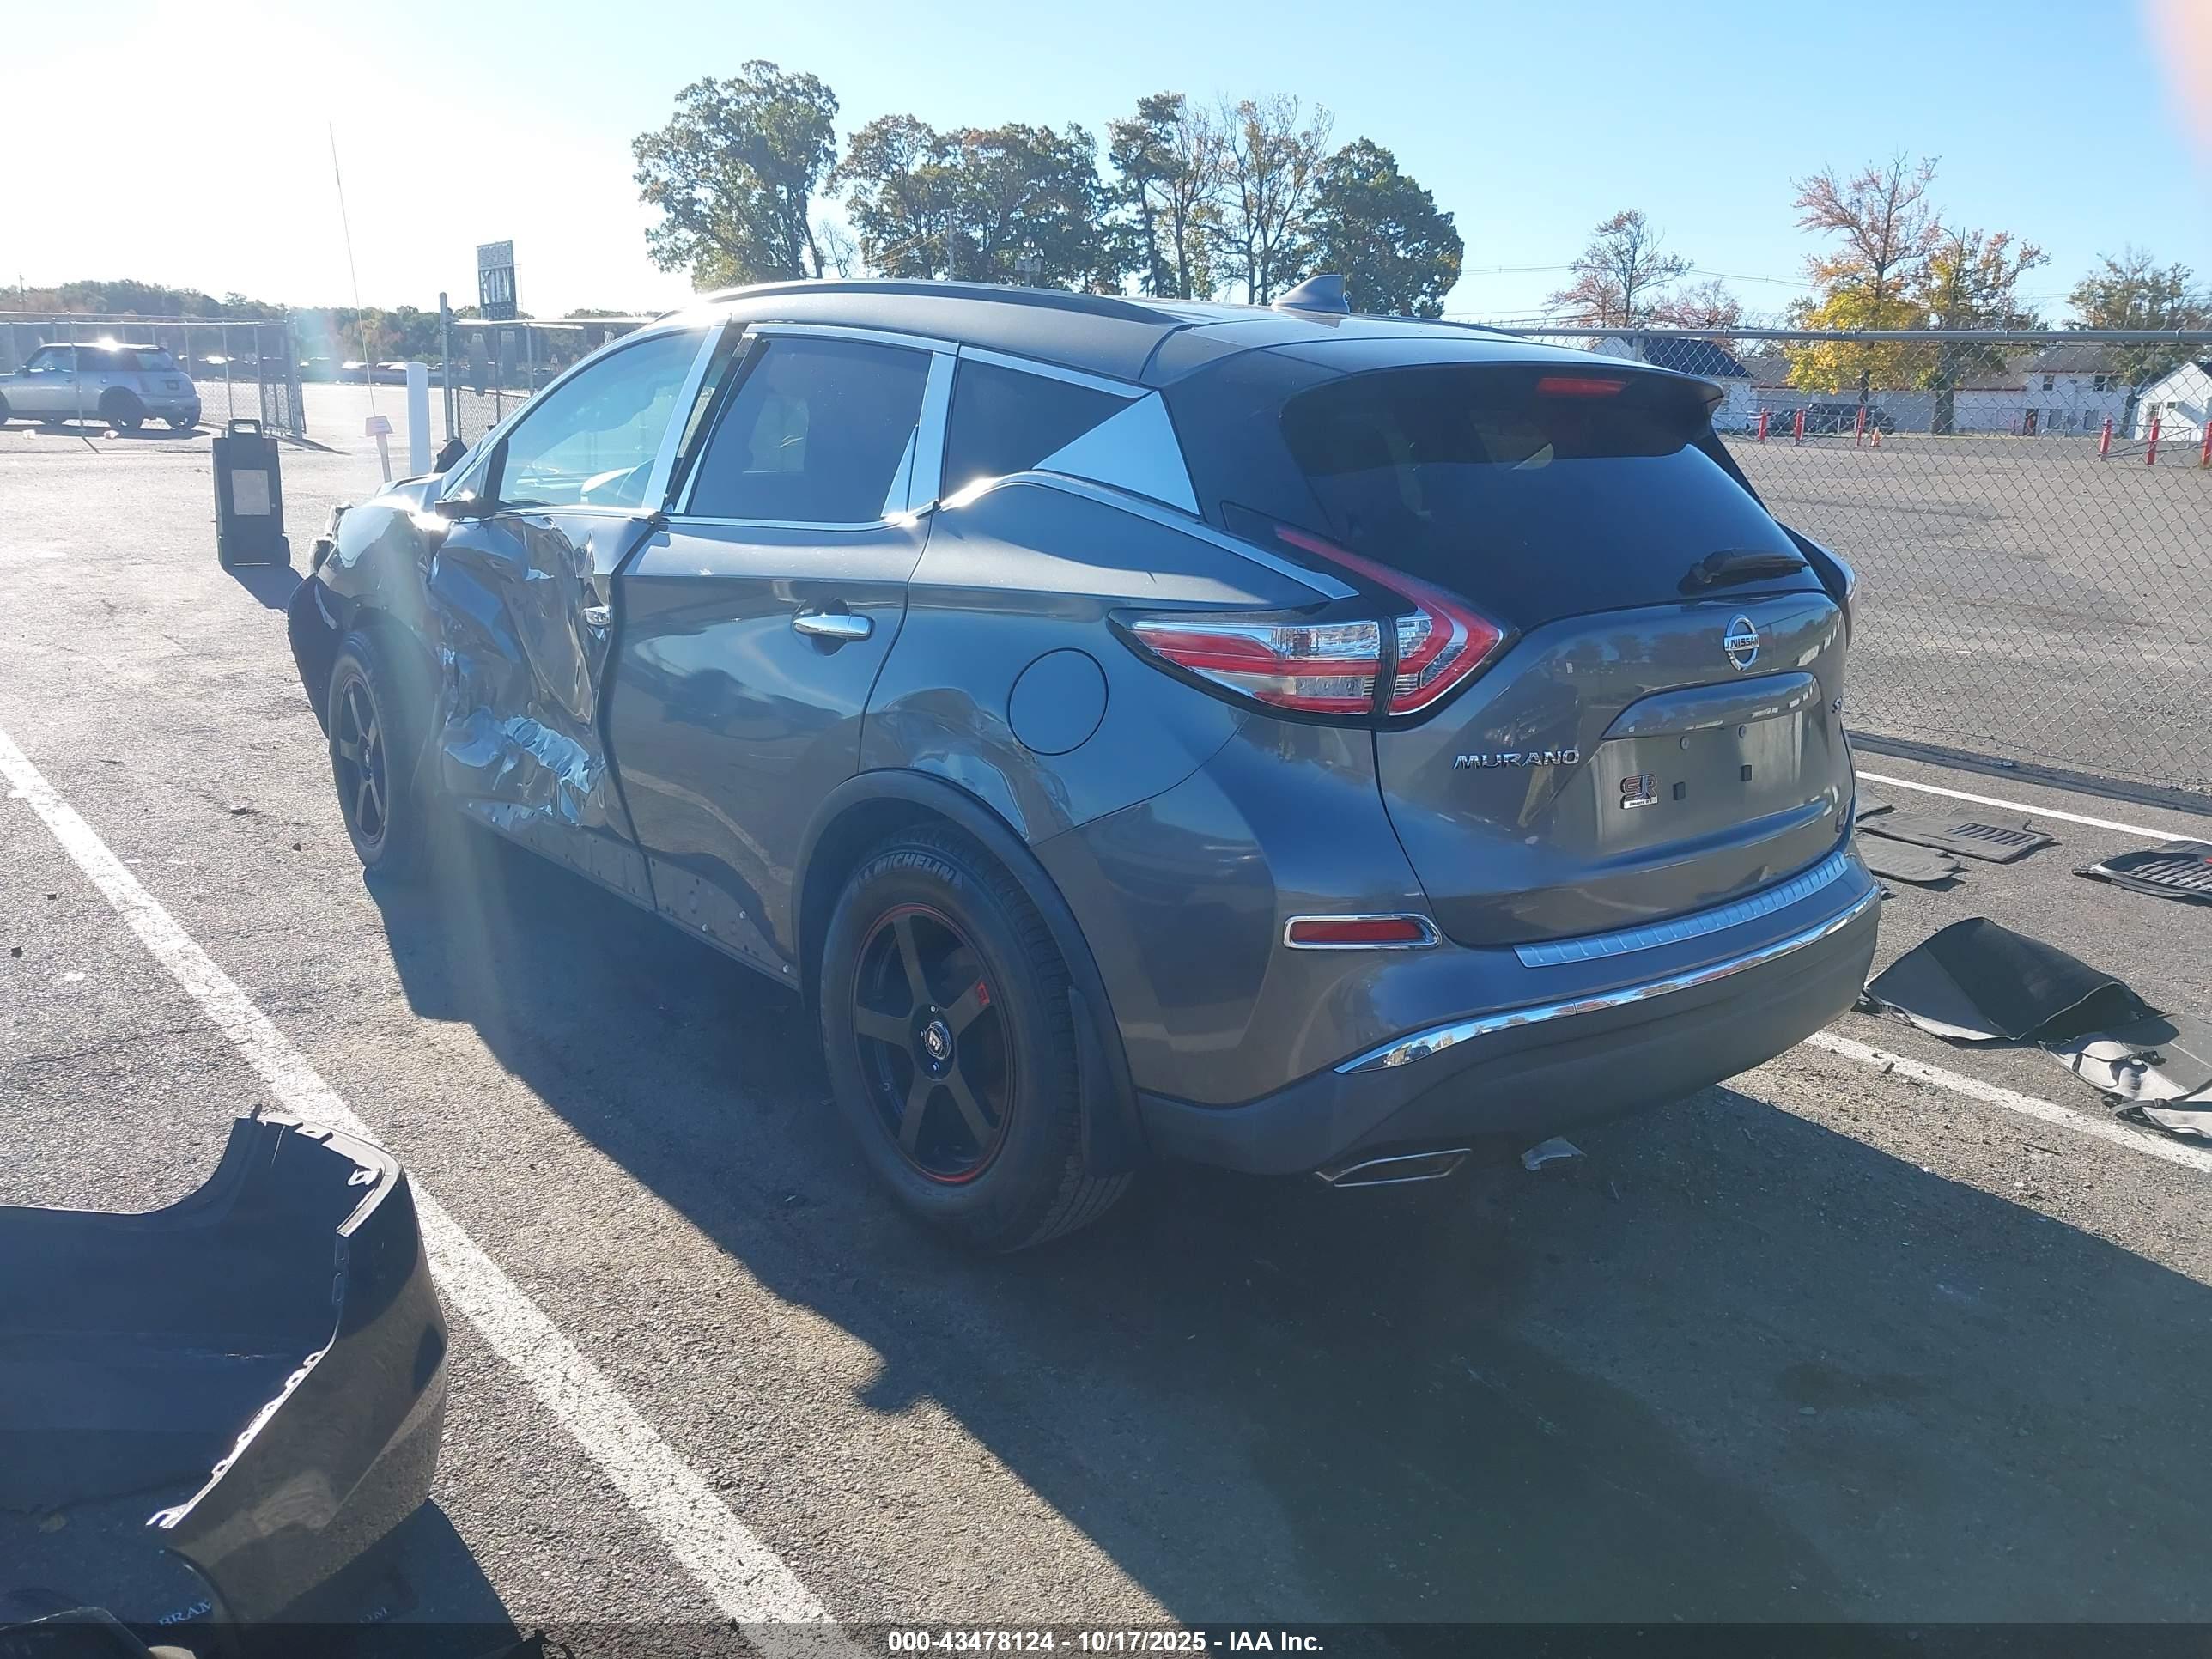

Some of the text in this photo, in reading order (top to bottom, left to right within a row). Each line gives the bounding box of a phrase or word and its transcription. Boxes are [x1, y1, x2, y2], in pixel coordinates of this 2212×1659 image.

[1730, 636, 1759, 650] NISSAN
[1453, 749, 1580, 770] MURANO
[873, 852, 956, 883] MICHELIN
